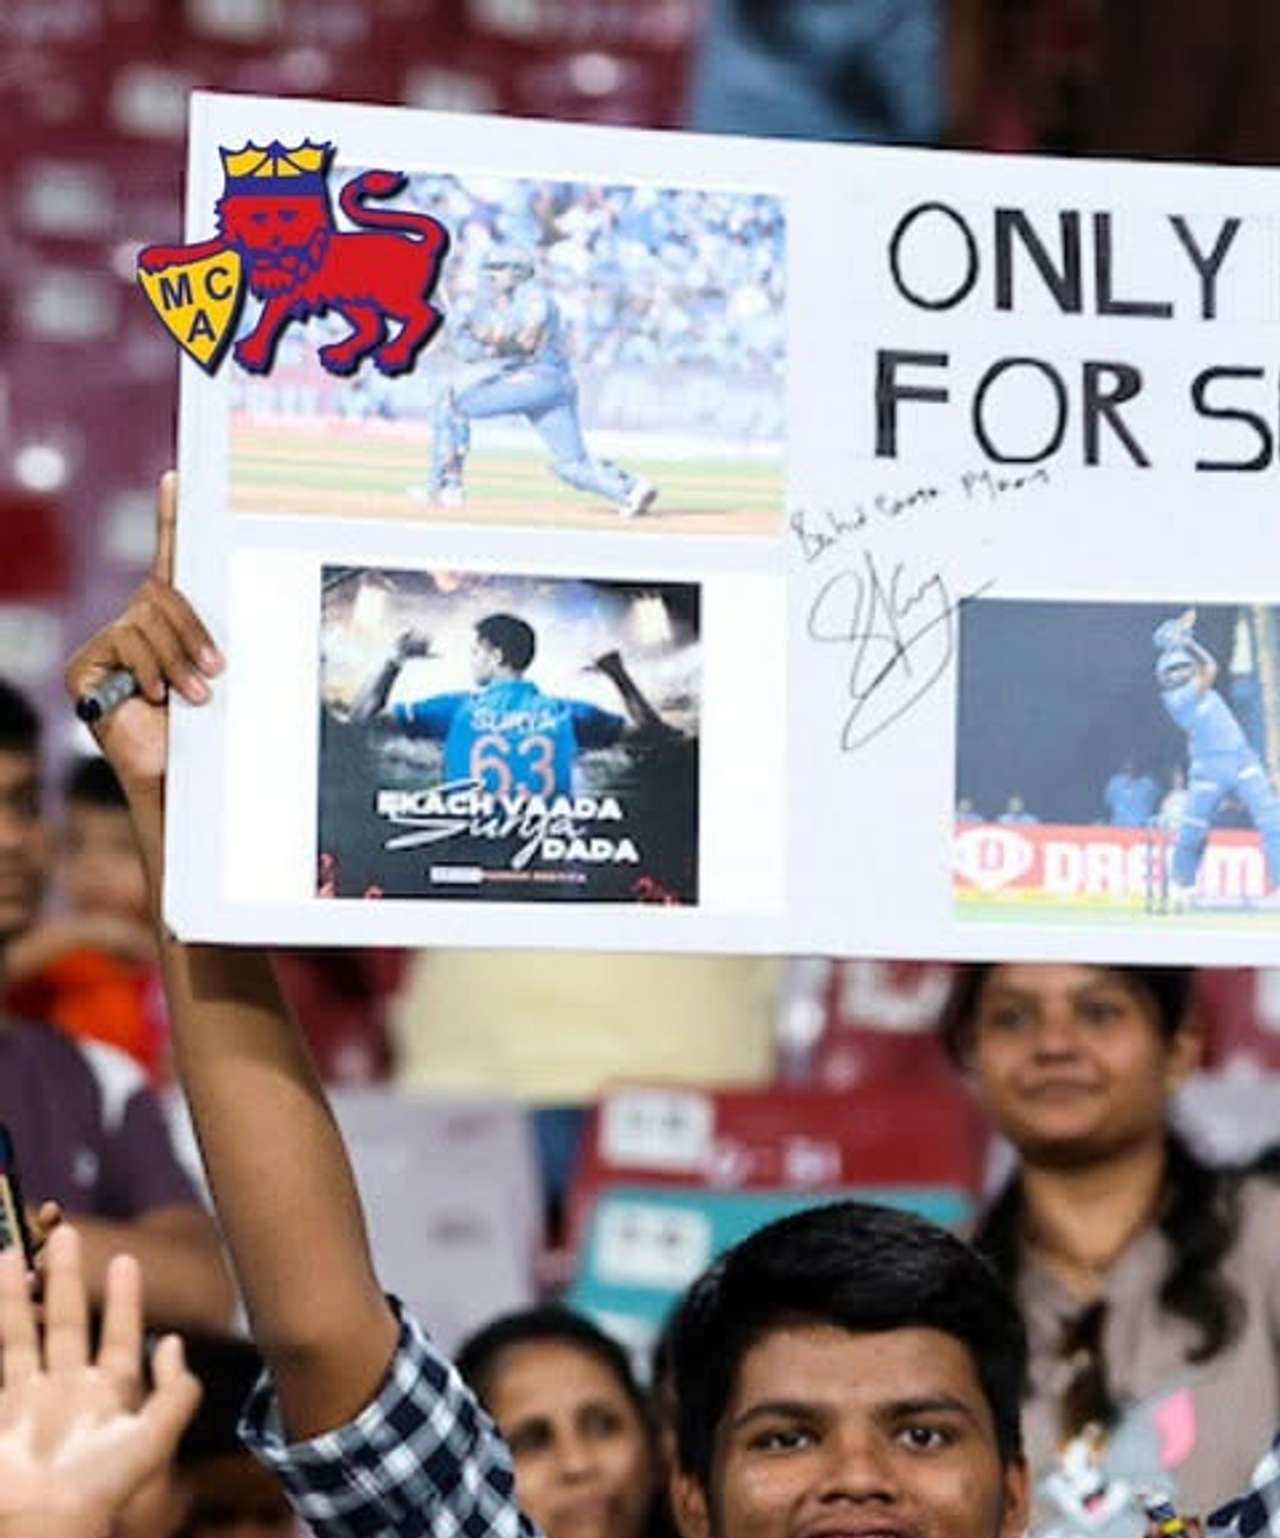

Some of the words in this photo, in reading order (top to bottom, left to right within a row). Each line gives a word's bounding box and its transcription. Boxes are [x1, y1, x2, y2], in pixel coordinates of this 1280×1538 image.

[889, 201, 1242, 320] ONLY
[873, 348, 1151, 468] FOR
[469, 736, 556, 803] 63
[503, 796, 623, 820] VAADA
[542, 837, 640, 863] DADA
